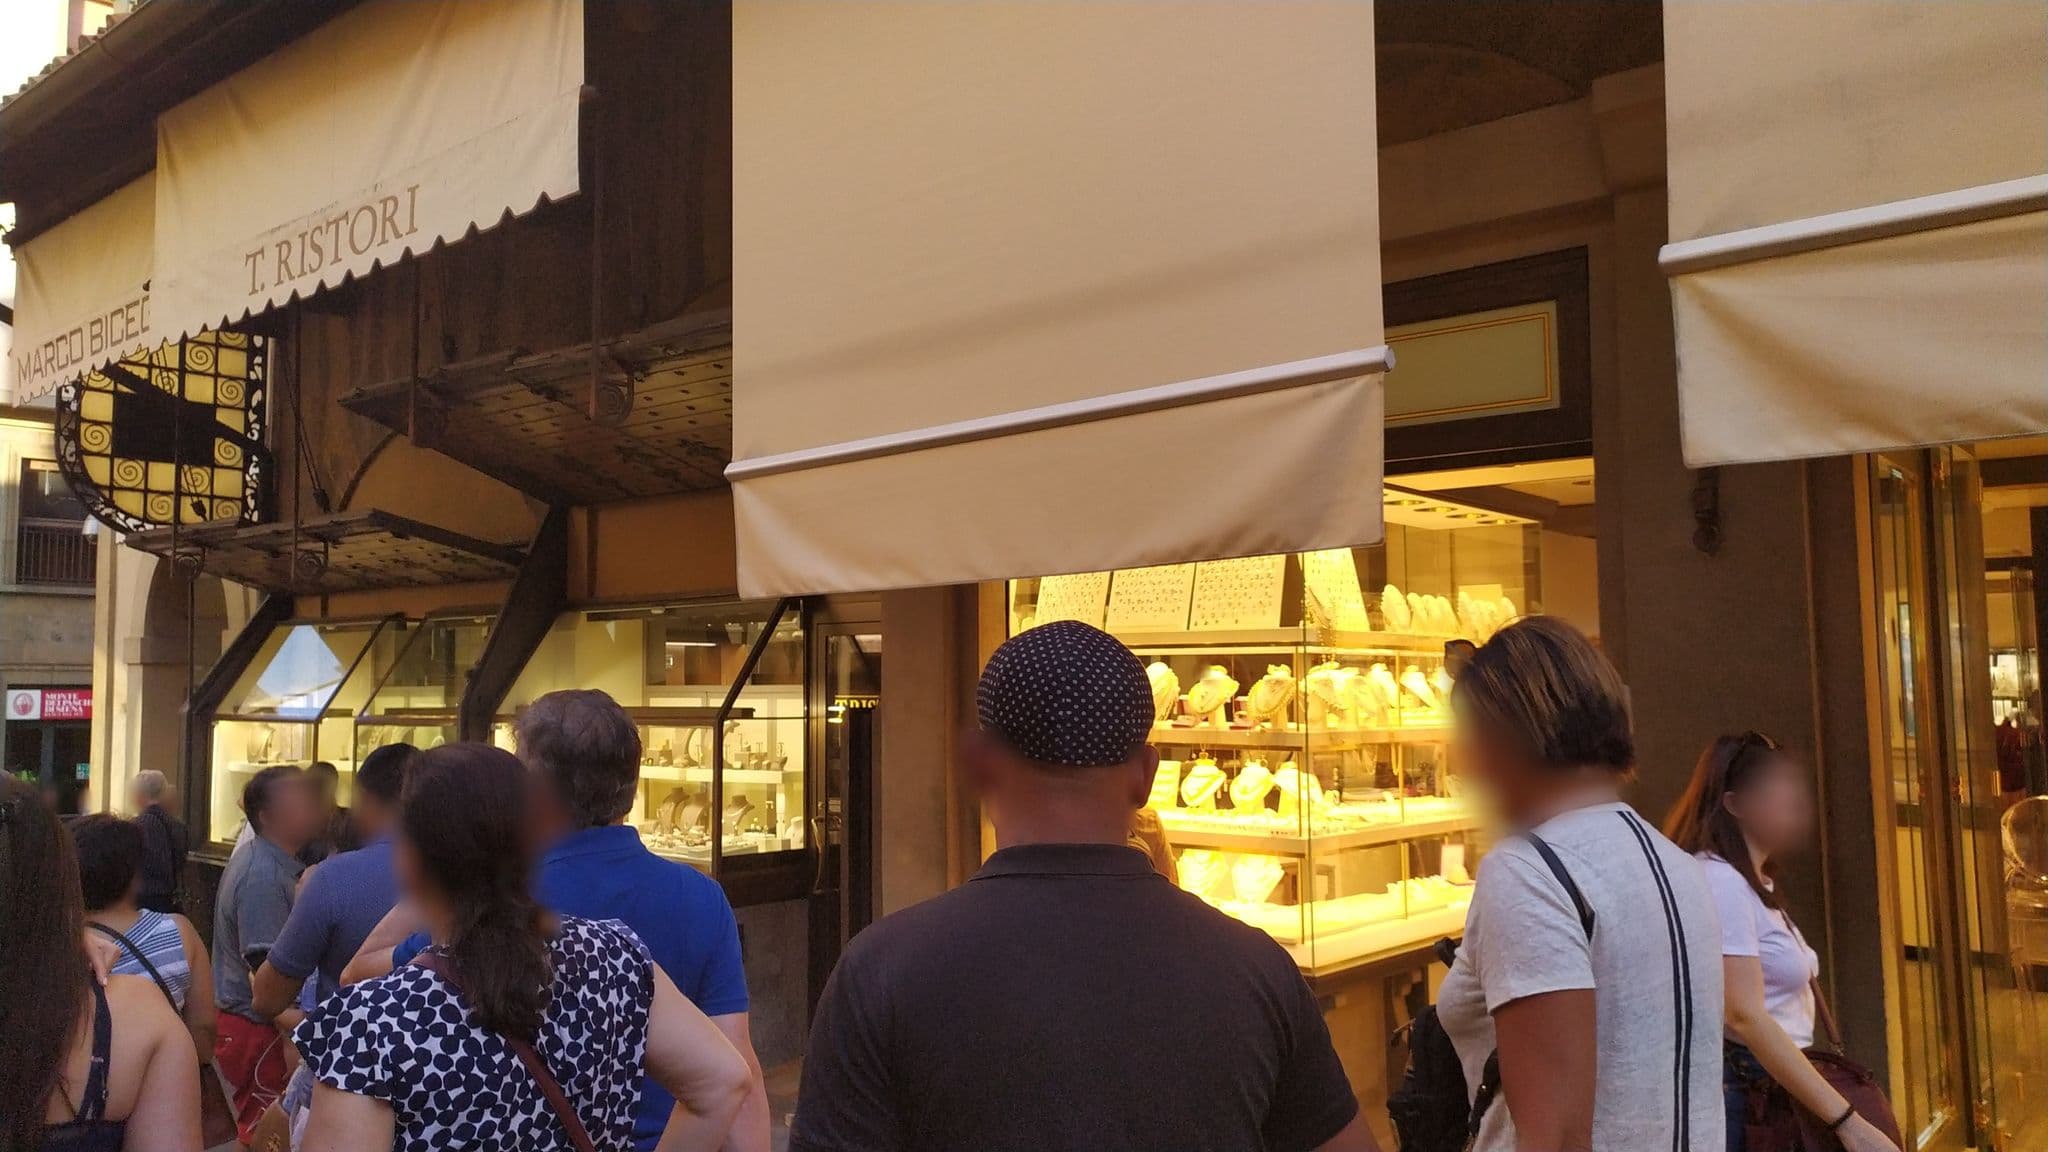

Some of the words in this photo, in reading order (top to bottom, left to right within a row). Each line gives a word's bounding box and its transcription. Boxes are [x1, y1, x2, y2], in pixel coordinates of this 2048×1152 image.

[244, 245, 265, 297] T.
[274, 184, 420, 287] RISTORI
[17, 327, 84, 388] MARCO
